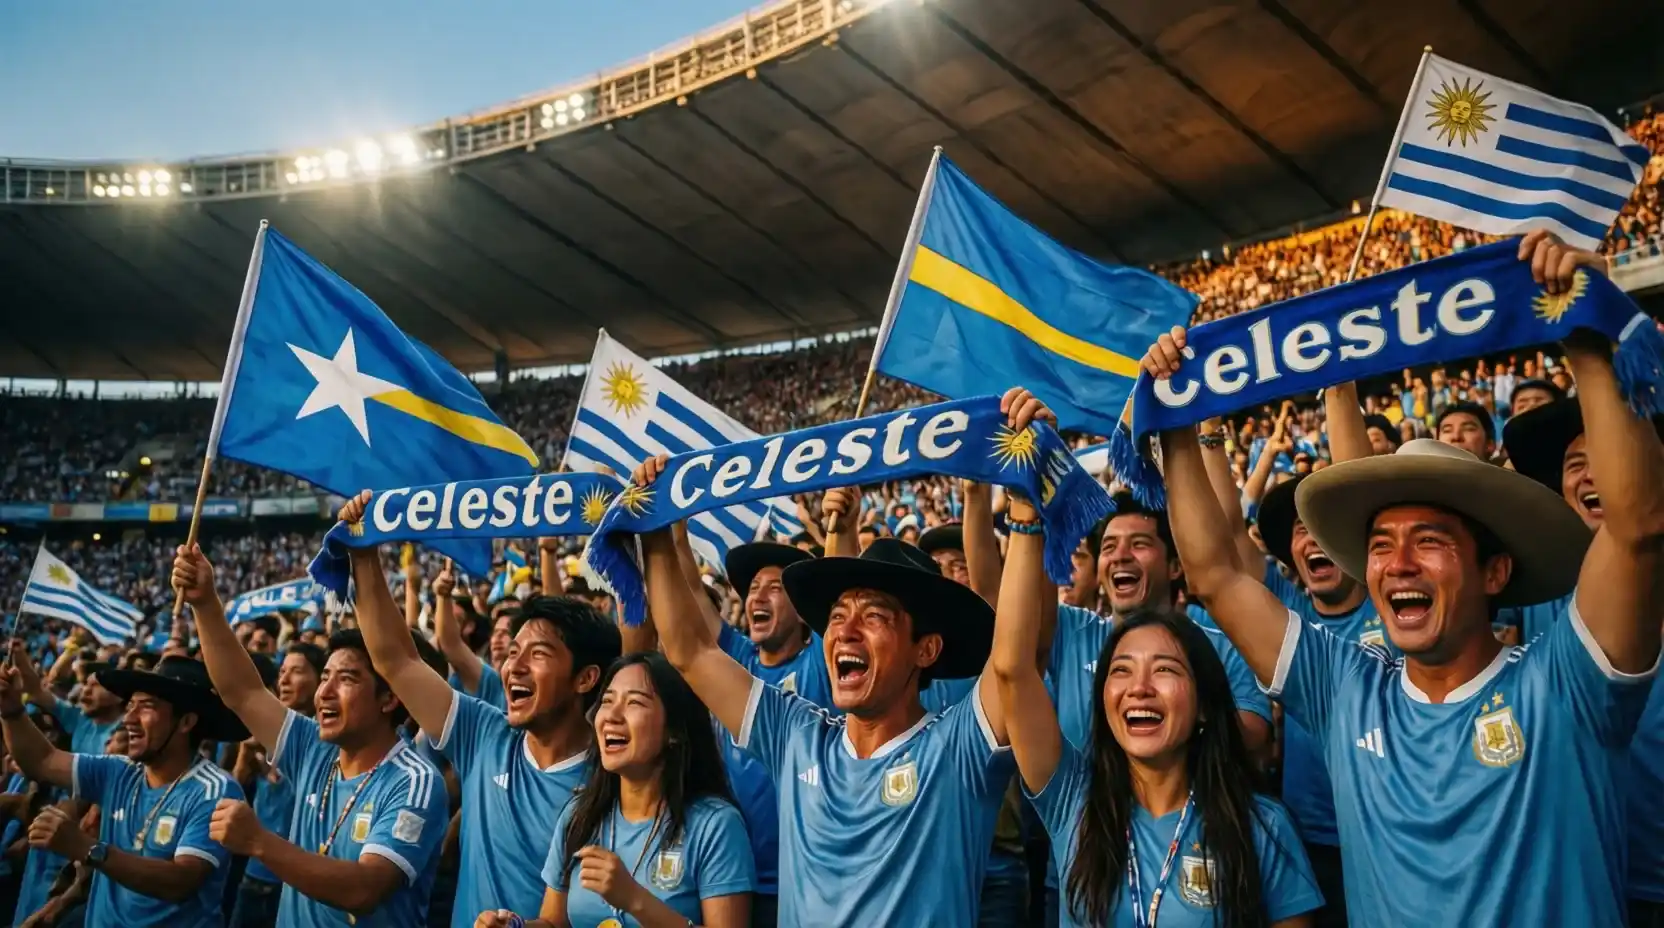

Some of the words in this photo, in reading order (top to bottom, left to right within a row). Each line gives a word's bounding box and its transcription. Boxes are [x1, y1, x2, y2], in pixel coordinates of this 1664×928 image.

[1153, 277, 1496, 408] Celeste
[372, 474, 573, 533] Celeste
[670, 409, 970, 509] Celeste
